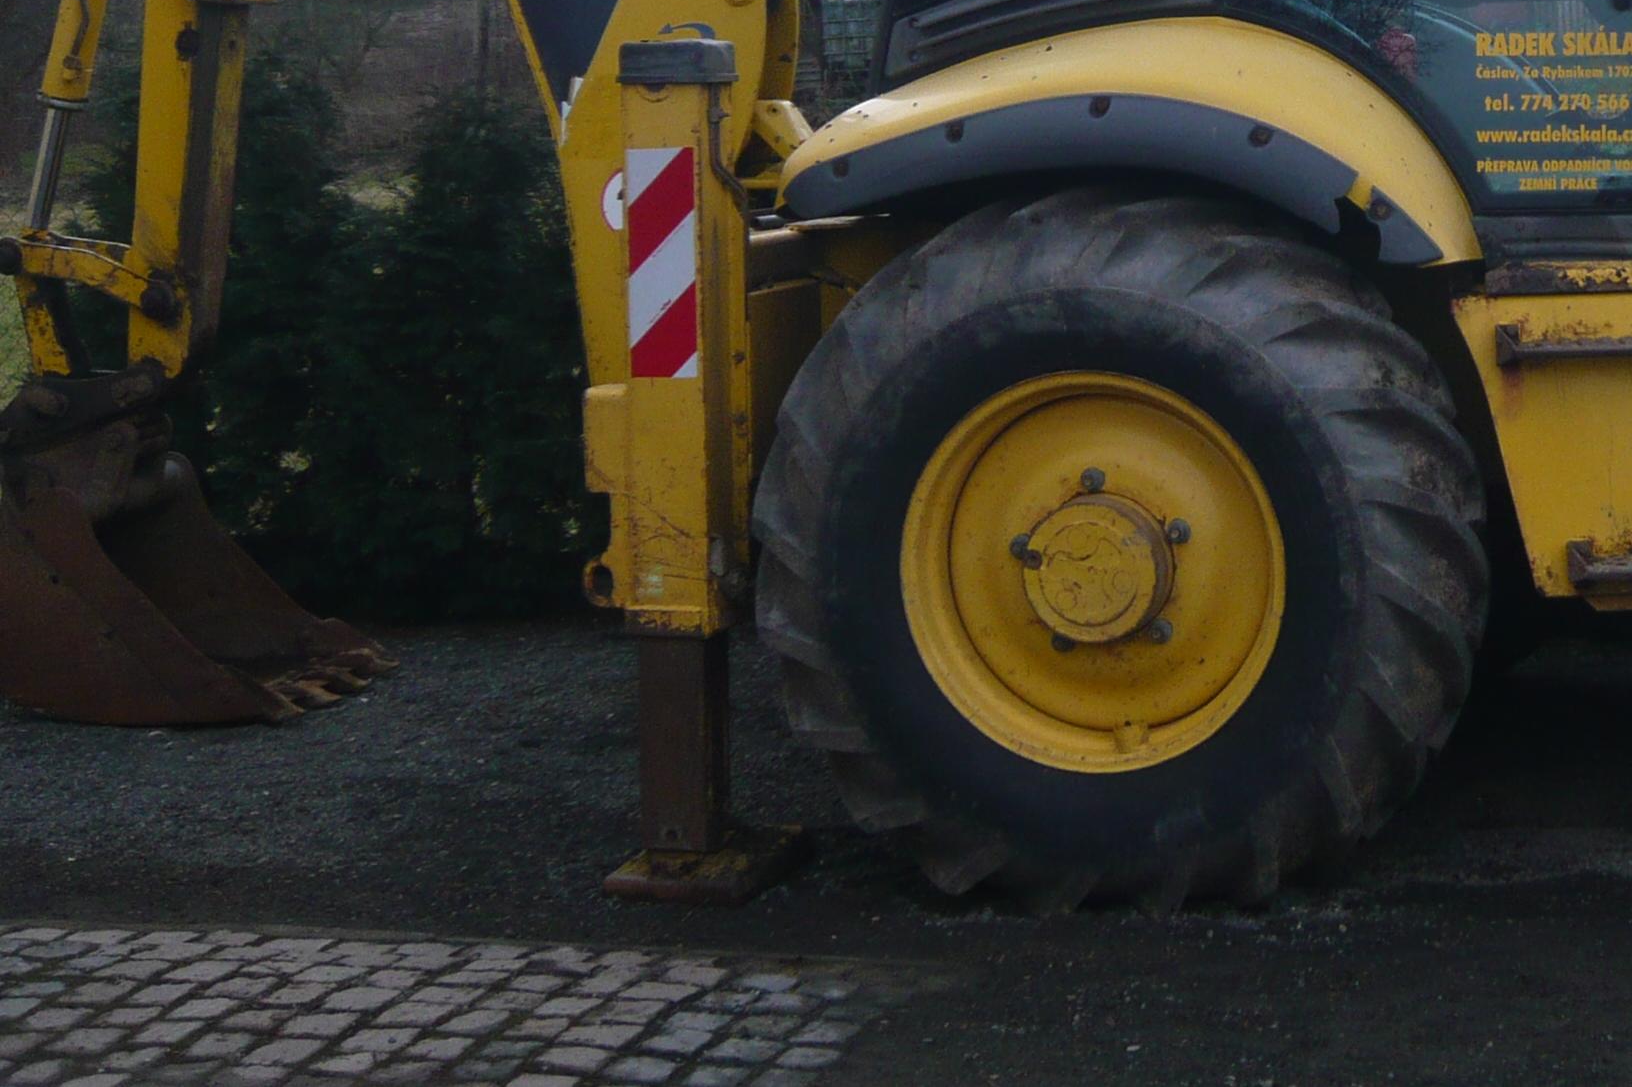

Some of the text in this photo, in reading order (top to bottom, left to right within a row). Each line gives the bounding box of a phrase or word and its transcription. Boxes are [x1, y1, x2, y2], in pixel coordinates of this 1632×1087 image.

[1476, 32, 1556, 57] RADEK
[1485, 93, 1630, 111] tel. 774 270 566
[1477, 157, 1538, 173] PŘEPRAVA
[1543, 156, 1612, 172] ODPADNÍCH
[1519, 174, 1598, 191] ZEMNÍ PRÁCE
